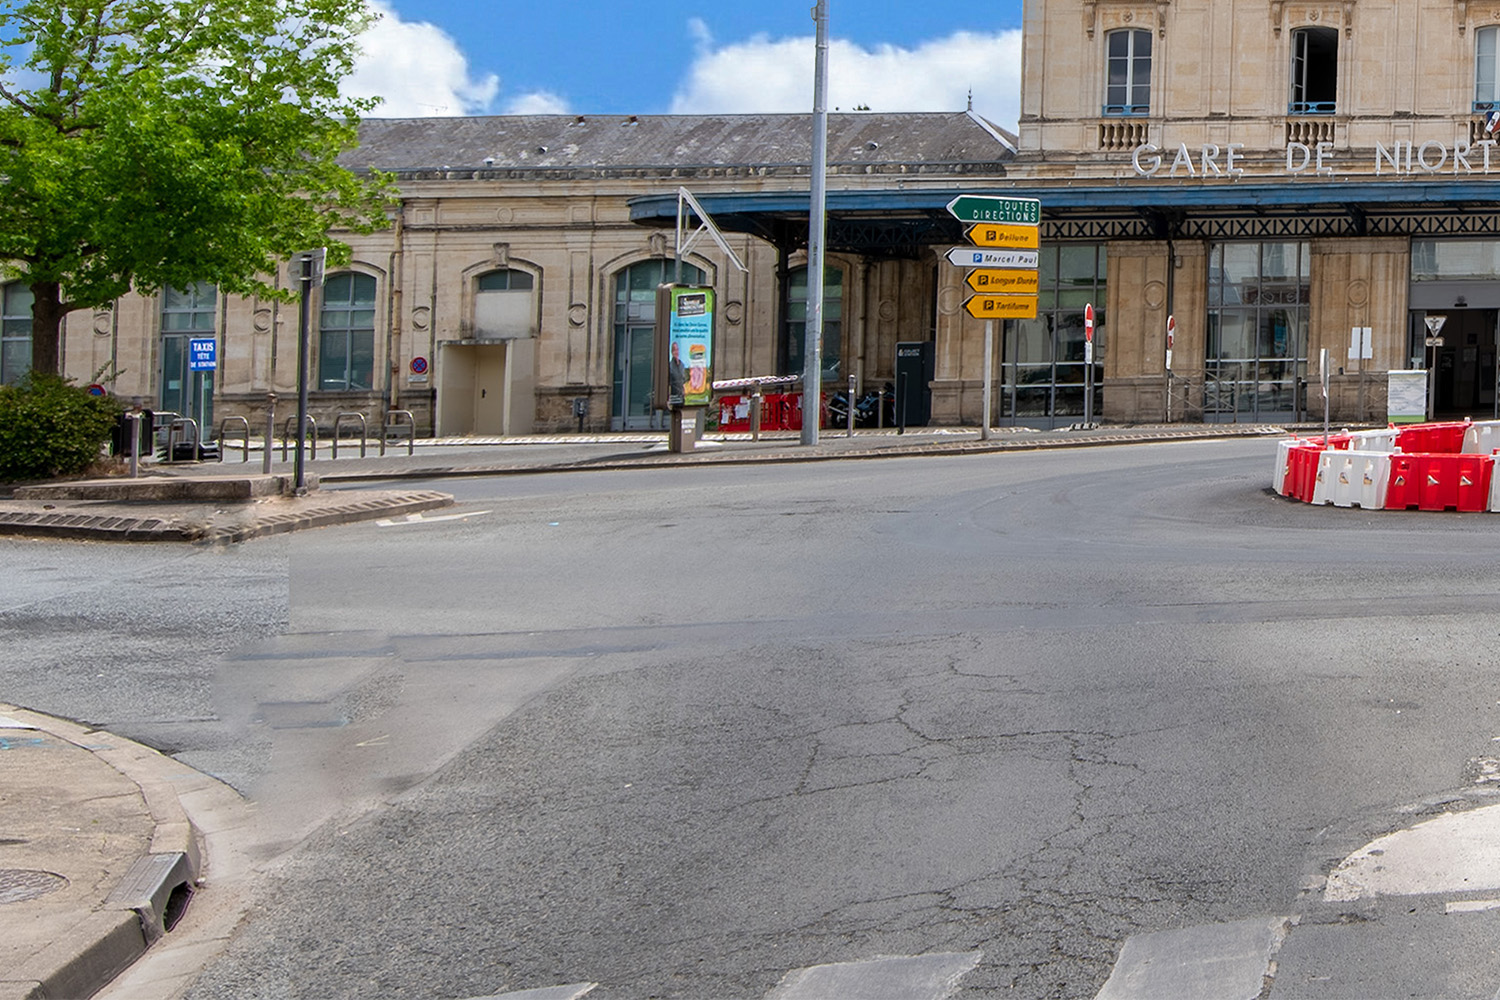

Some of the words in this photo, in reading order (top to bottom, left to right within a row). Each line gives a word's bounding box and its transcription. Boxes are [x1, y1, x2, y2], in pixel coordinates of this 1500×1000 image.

[1132, 142, 1244, 176] GARE
[1286, 141, 1334, 173] DE
[1376, 139, 1497, 171] NIORT
[999, 200, 1037, 212] TOUTES
[972, 209, 1037, 222] DIRECTIONS
[984, 254, 1015, 263] Marcel
[1017, 255, 1037, 264] Paul
[990, 276, 1016, 287] Longue
[1016, 276, 1038, 285] Durée
[193, 342, 214, 352] TAXIS
